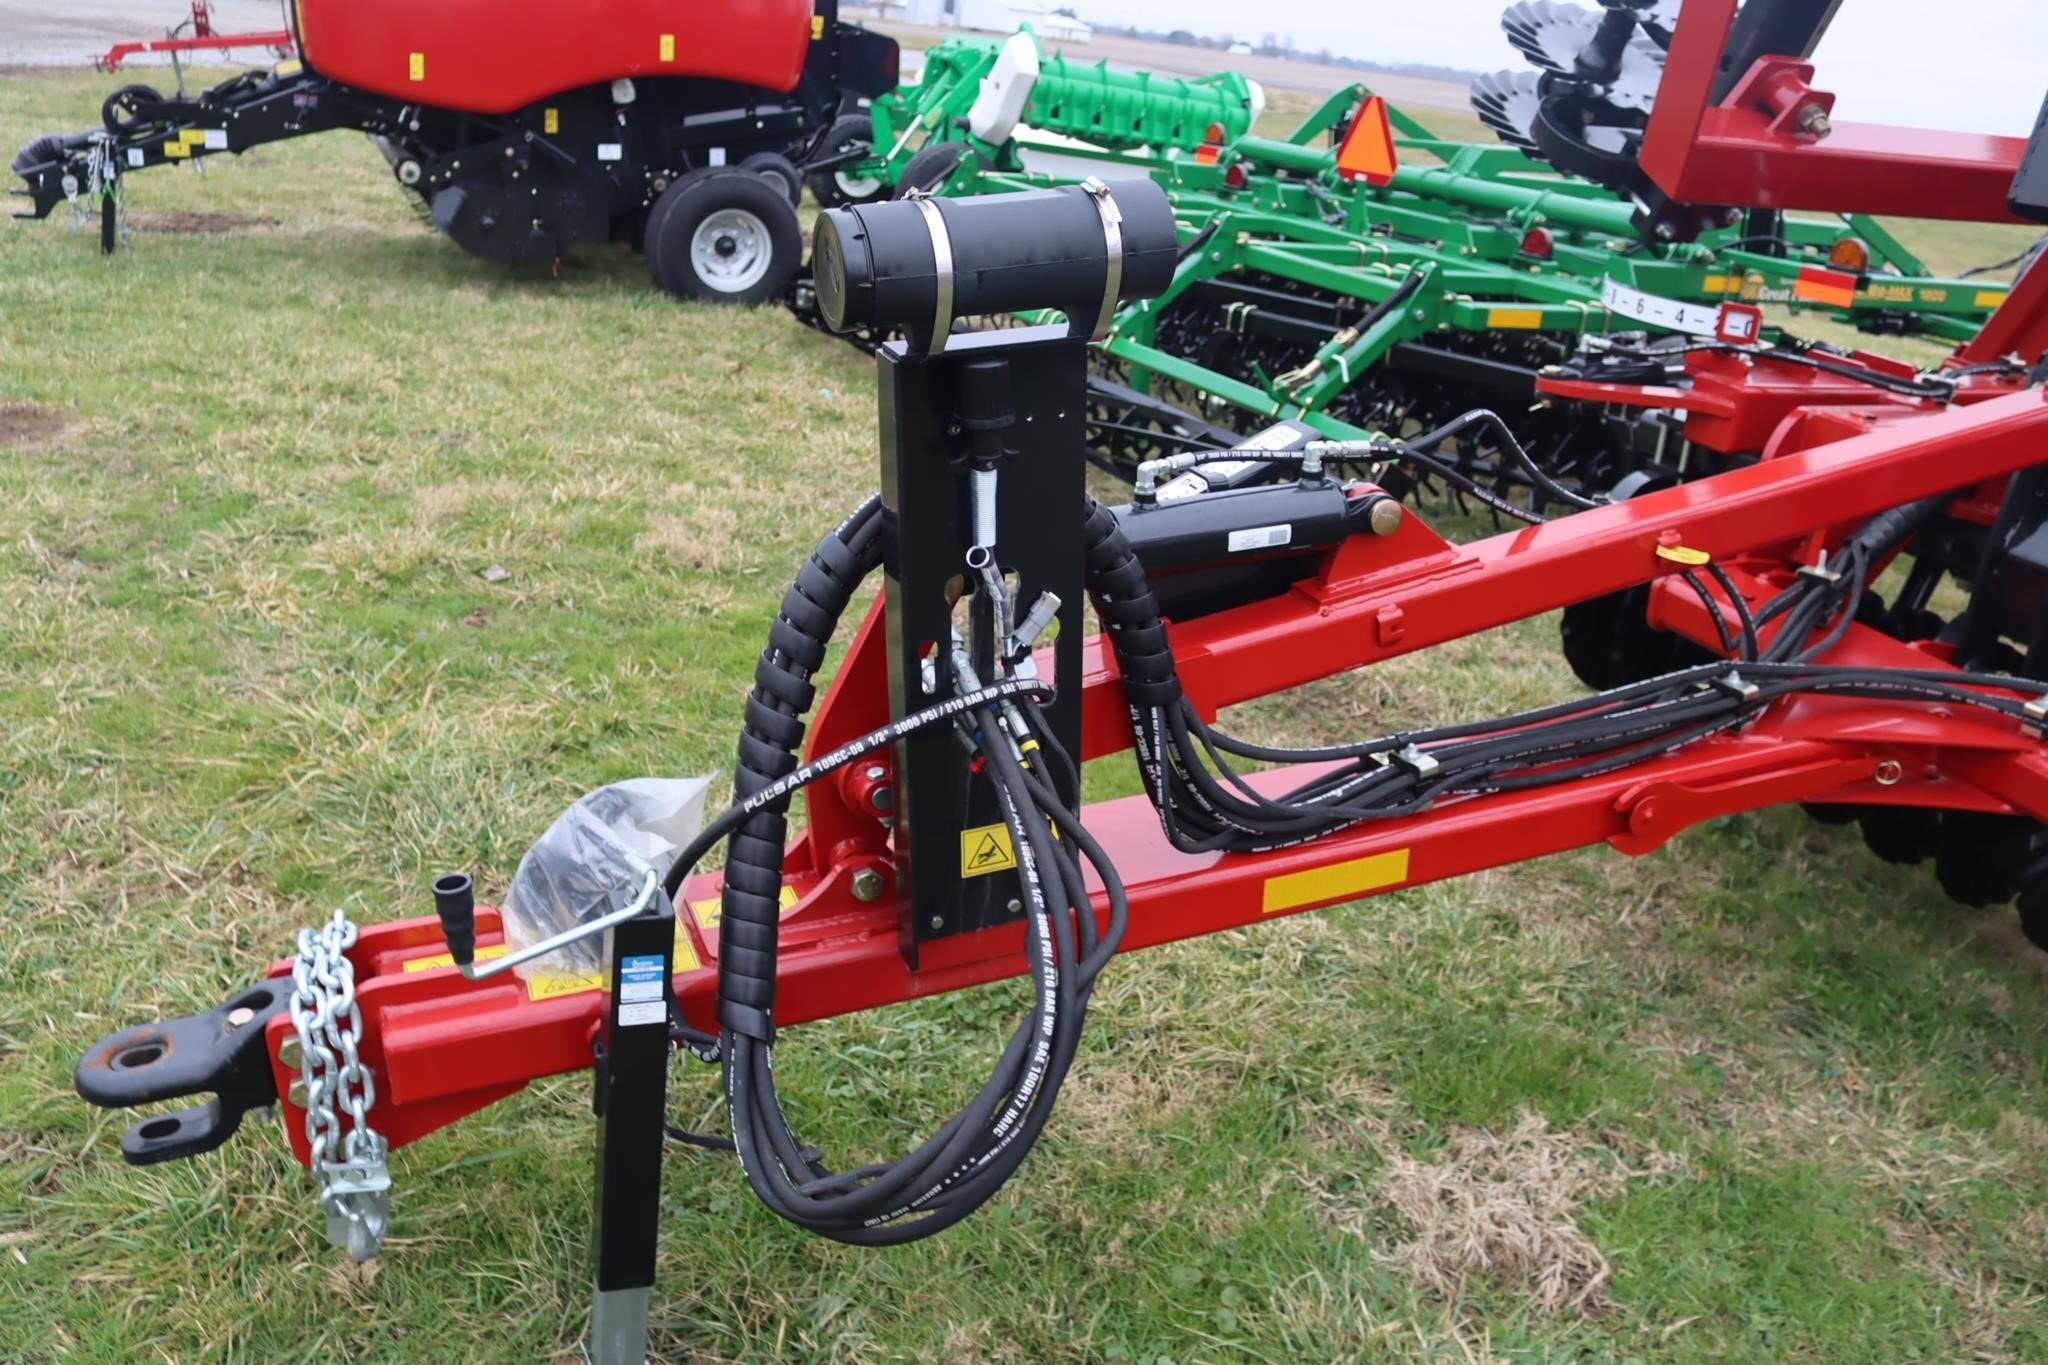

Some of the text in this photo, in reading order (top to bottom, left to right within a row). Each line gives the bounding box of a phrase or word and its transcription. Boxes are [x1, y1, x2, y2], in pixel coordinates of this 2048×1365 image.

[1636, 298, 1645, 314] 6
[1674, 309, 1685, 324] 4
[744, 767, 812, 813] PULSAR
[815, 742, 865, 773] 109CC-08
[868, 729, 890, 748] 1/2"
[894, 716, 920, 735] 3000
[921, 709, 938, 723] PSI
[946, 700, 964, 714] 210
[964, 693, 984, 707] BAR
[984, 687, 998, 700] WP
[1000, 682, 1016, 695] SAE
[1036, 912, 1050, 939] 3000
[1041, 940, 1053, 957] PSI
[1044, 966, 1056, 988] 210
[1045, 990, 1056, 1013] BAR
[1042, 1015, 1054, 1036] WP
[1034, 1041, 1049, 1064] SAE
[1015, 1066, 1042, 1109] 100R17
[992, 1108, 1019, 1138] HARC
